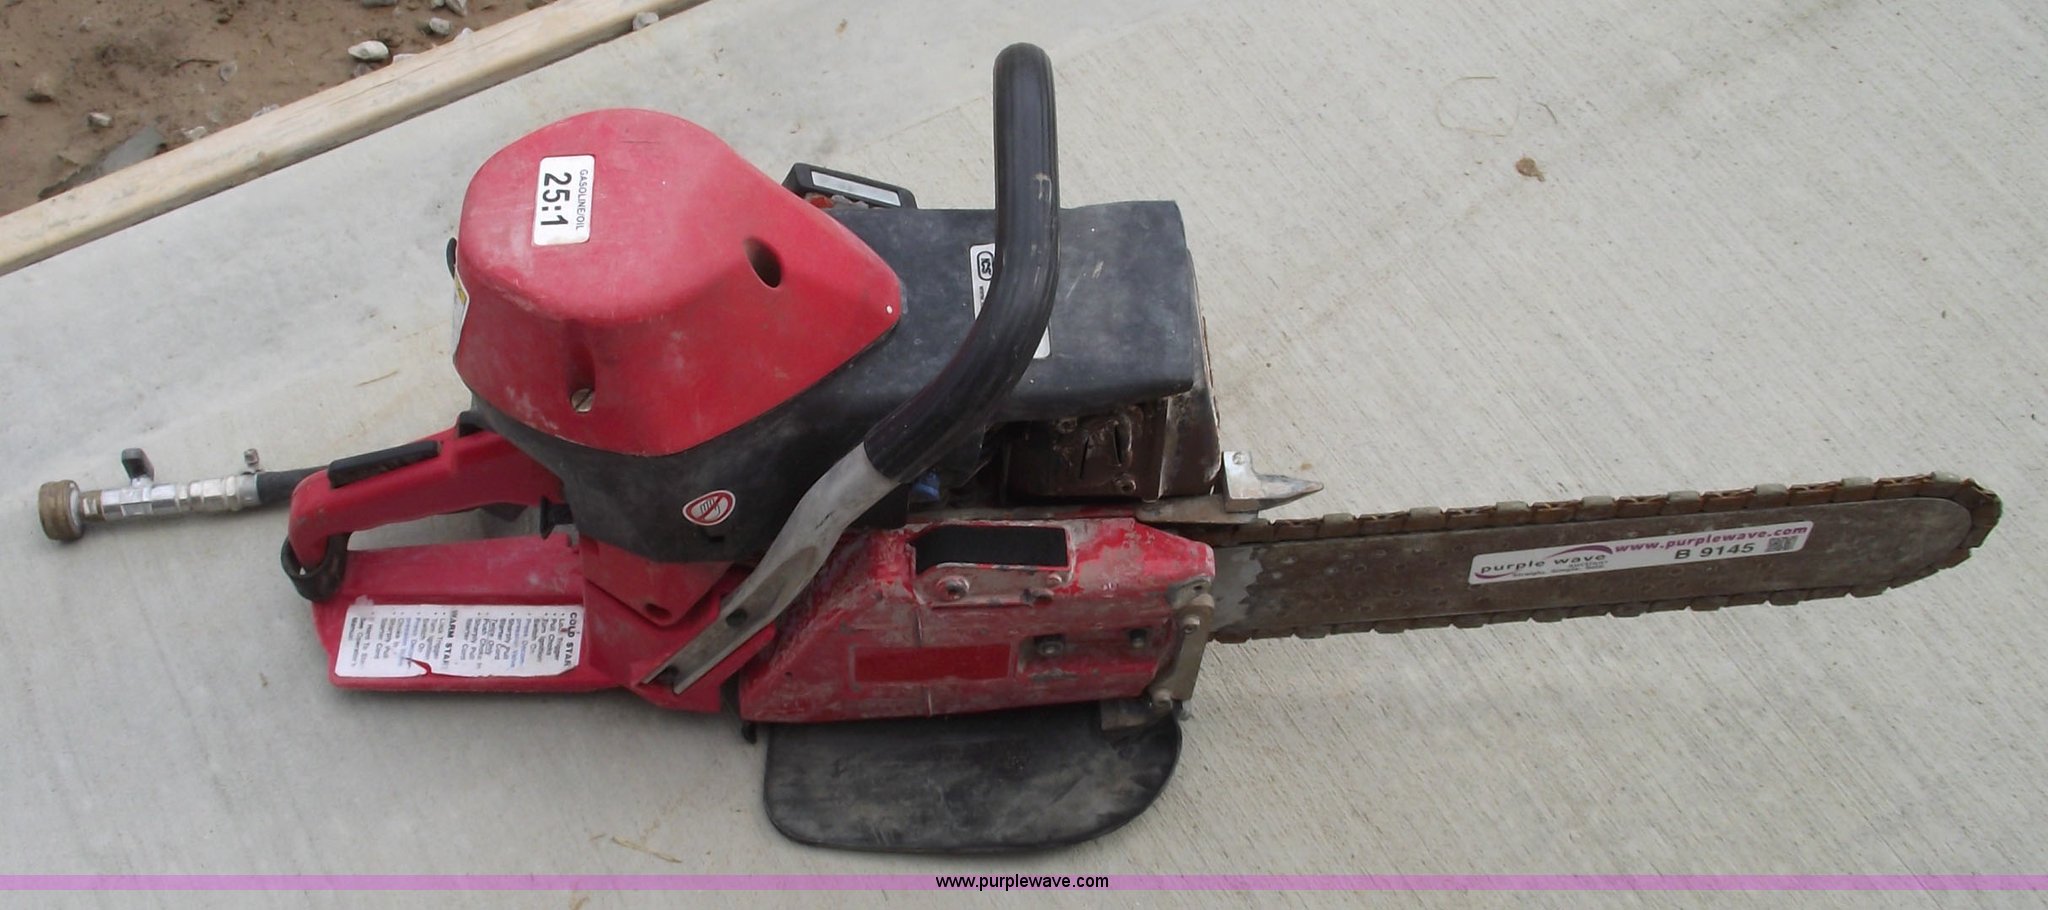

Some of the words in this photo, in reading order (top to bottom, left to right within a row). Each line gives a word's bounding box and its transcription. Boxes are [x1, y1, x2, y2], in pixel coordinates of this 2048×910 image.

[541, 172, 572, 225] 25:1
[576, 169, 588, 230] GASOLINE/OIL
[1615, 526, 1807, 552] www.purplewave.com
[1675, 549, 1690, 560] B
[1700, 542, 1755, 557] 9145
[1481, 560, 1545, 573] purple
[1554, 554, 1606, 565] wave
[448, 610, 458, 638] WARM
[568, 612, 577, 637] COLD
